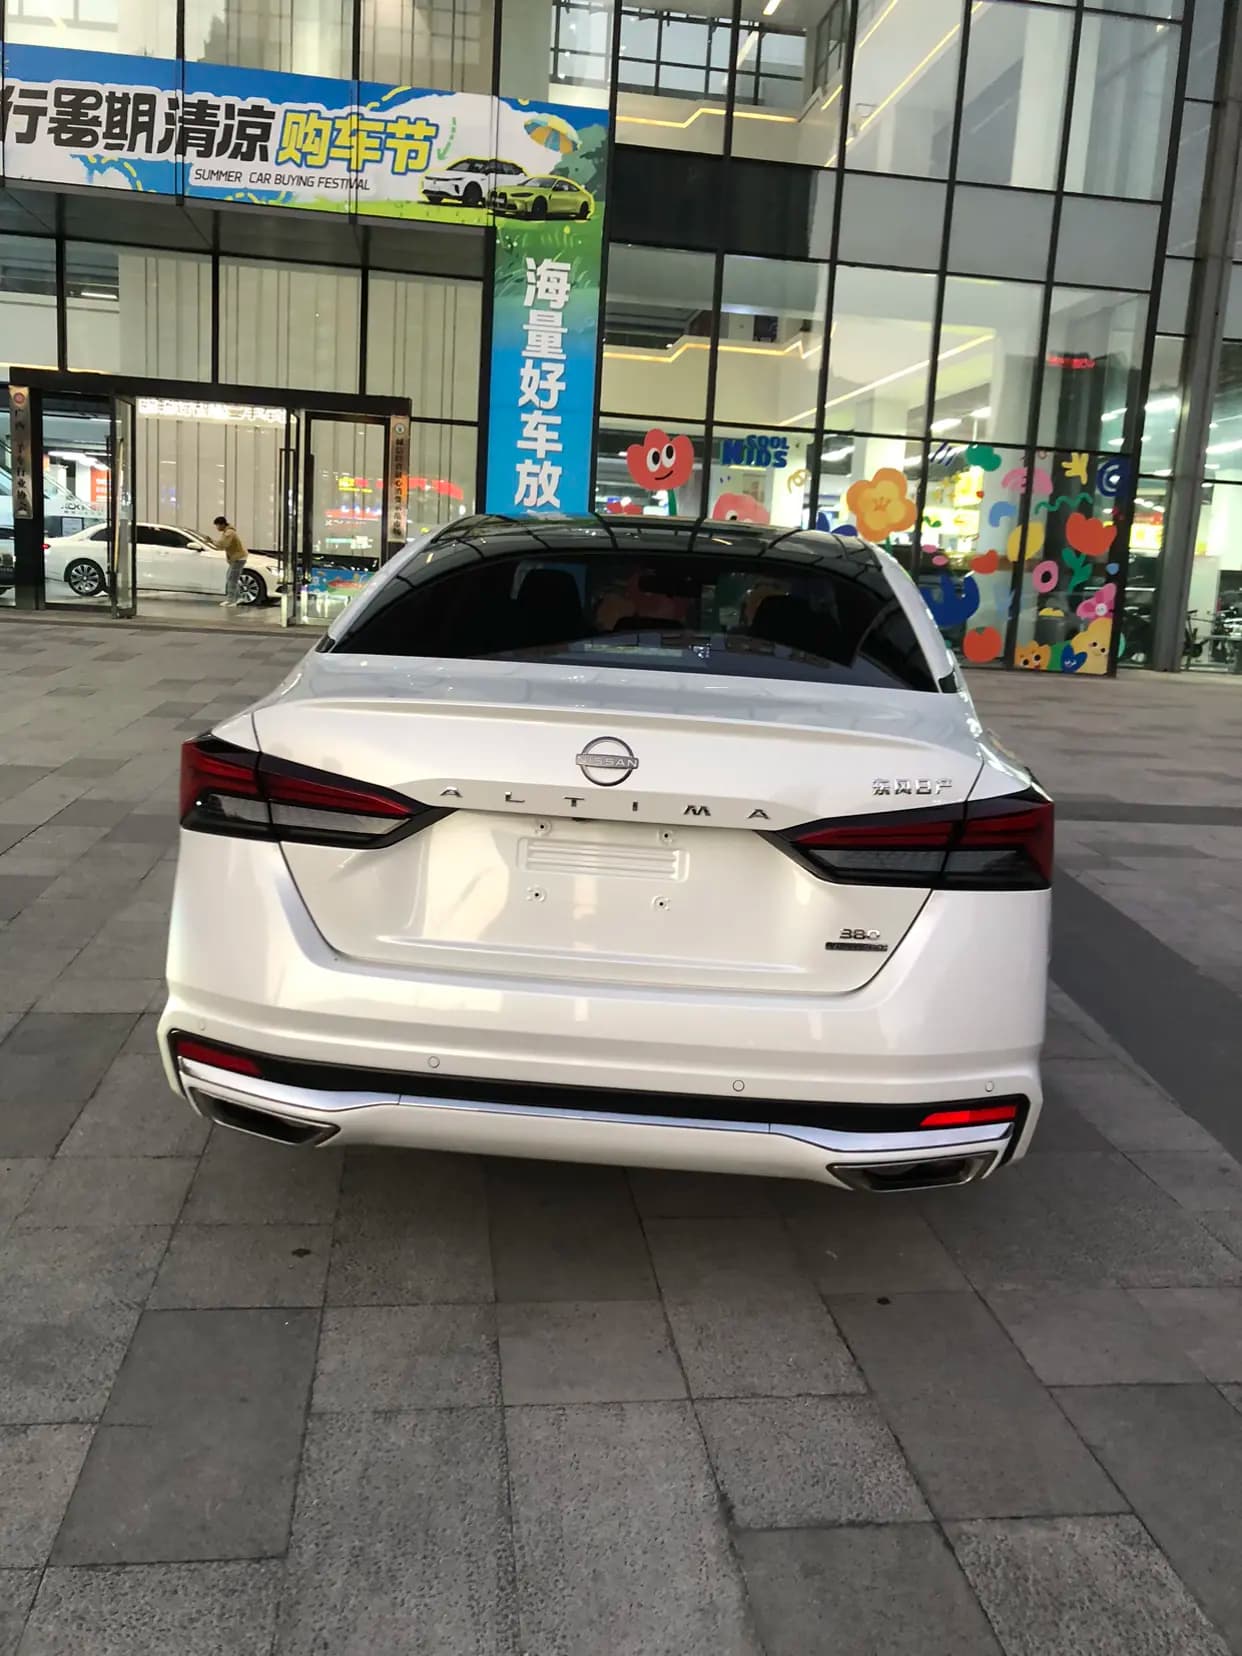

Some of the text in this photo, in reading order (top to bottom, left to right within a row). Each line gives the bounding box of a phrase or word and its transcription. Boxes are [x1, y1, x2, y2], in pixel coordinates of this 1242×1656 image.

[194, 168, 370, 191] SUMMER CAR BUYING FESTIVAL
[514, 257, 572, 519] 海量好车放
[746, 434, 790, 450] COOL
[578, 754, 638, 768] NISSAN
[872, 778, 953, 795] 东风日产
[440, 786, 771, 821] ALTIMA
[839, 927, 881, 941] 380
